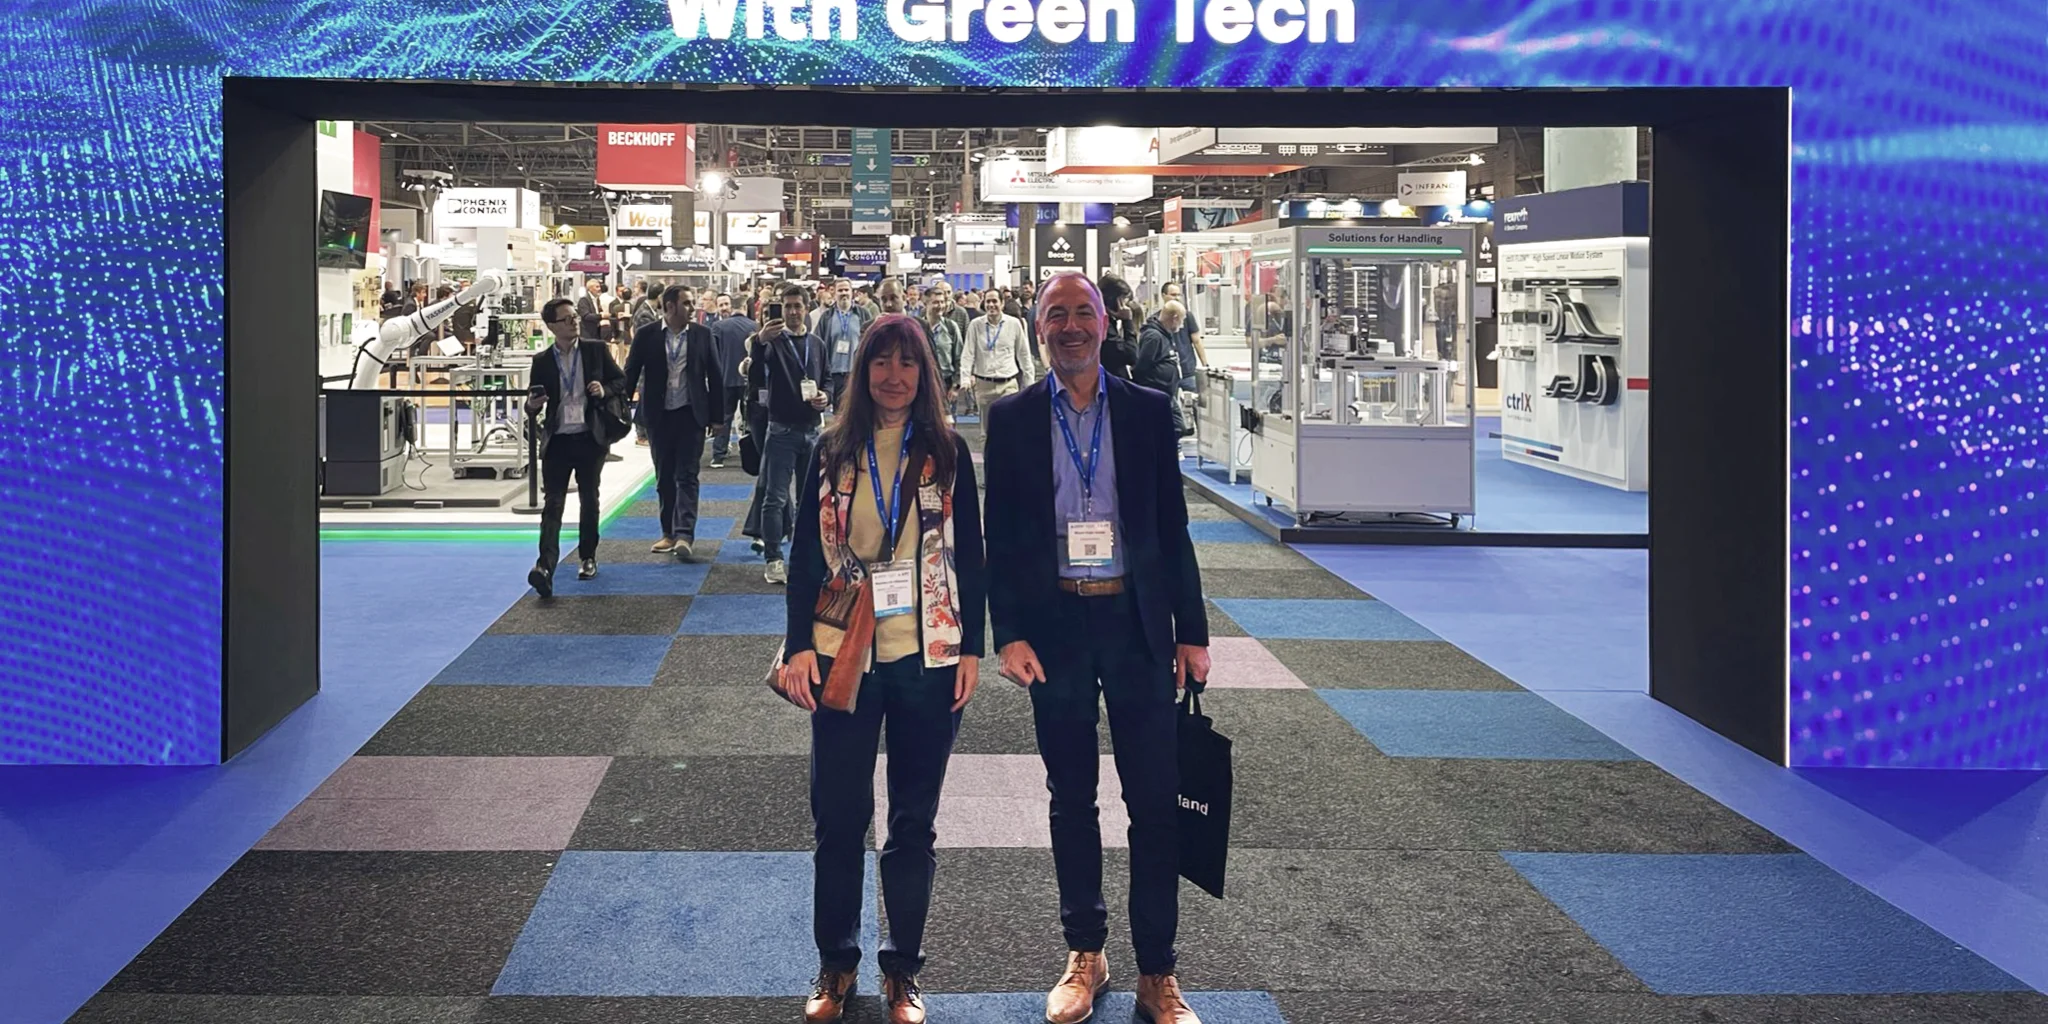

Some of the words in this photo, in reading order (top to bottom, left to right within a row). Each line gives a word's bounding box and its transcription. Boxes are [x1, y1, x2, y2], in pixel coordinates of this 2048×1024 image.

[667, 0, 858, 41] With
[885, 0, 1136, 43] Green
[1174, 0, 1355, 43] Tech
[608, 131, 676, 147] BECKHOFF
[463, 206, 507, 214] CONTACT
[1328, 233, 1376, 243] Solutions
[1380, 234, 1394, 243] for
[1397, 234, 1443, 245] Handling
[426, 301, 455, 320] YASKAWA
[1506, 392, 1532, 413] ctrlX
